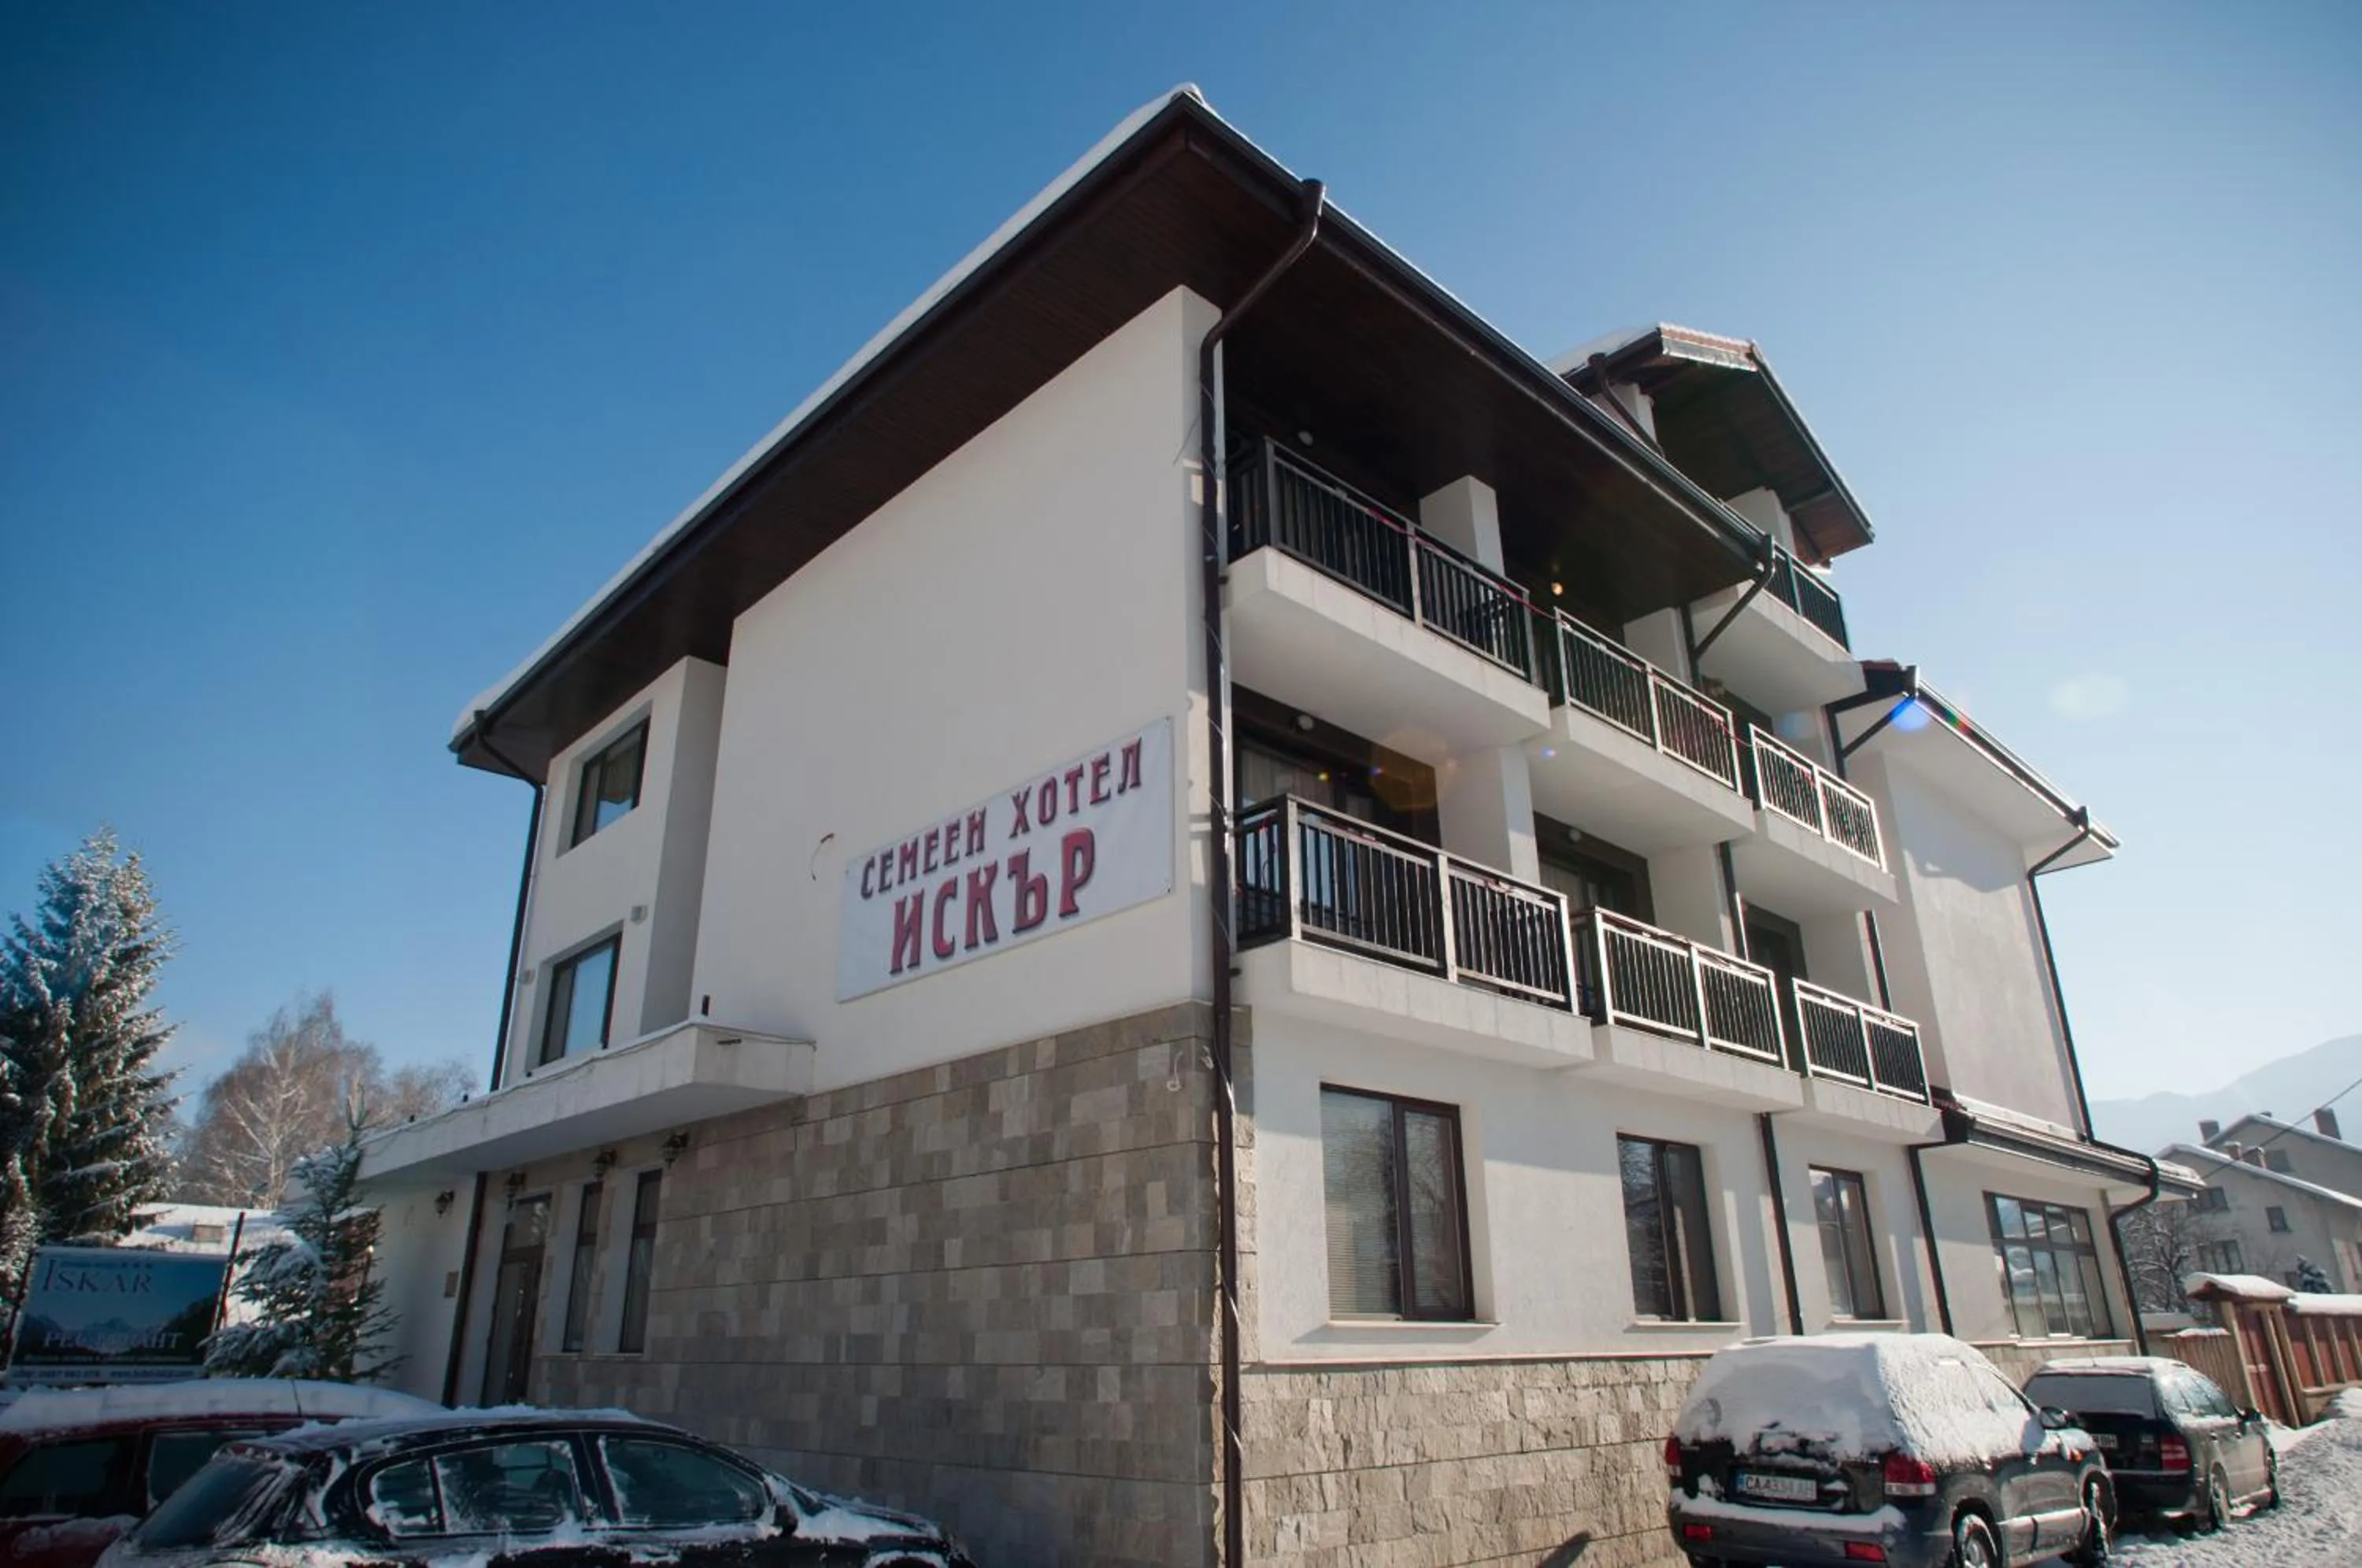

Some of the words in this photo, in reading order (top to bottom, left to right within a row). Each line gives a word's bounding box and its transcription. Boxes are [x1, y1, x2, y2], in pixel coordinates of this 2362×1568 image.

[860, 806, 987, 900] СЕМЕЕН
[1008, 737, 1142, 839] ХОТЕЛ
[889, 827, 1096, 975] ИСКЪР
